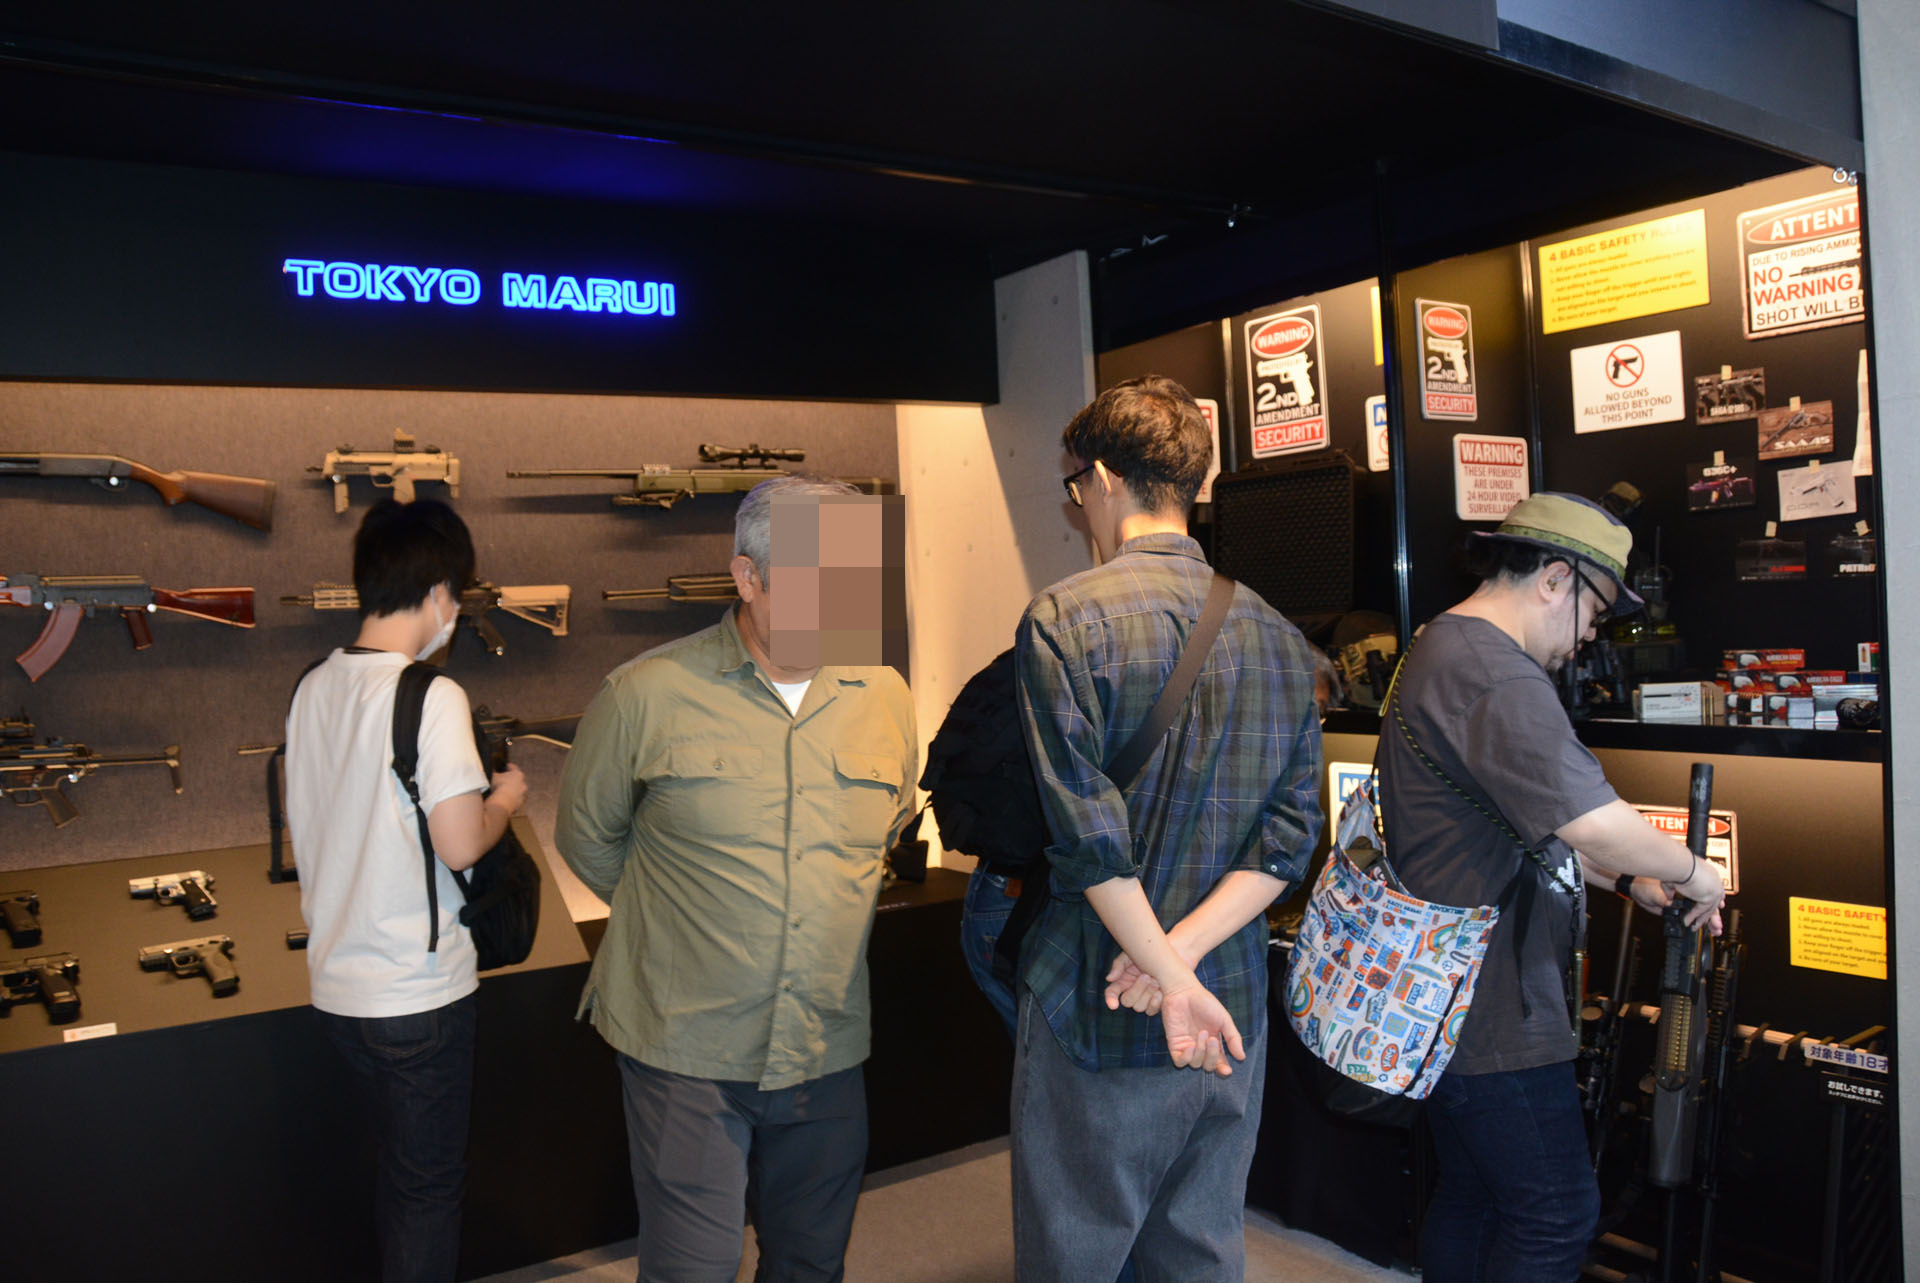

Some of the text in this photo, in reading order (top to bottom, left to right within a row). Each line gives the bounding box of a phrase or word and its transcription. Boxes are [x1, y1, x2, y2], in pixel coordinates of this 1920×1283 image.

[1770, 202, 1859, 241] ATTENT
[1549, 251, 1556, 262] 4
[1559, 242, 1595, 260] BASIC
[1599, 230, 1646, 251] SAFETY
[1752, 237, 1860, 266] DUE TO RISING AMMU
[1753, 266, 1783, 287] NO
[283, 259, 676, 317] TOKYO MARUI
[1754, 273, 1855, 307] WARNING
[1756, 296, 1860, 326] SHOT WILL B
[1428, 315, 1464, 330] WARNING
[1257, 325, 1309, 348] WARNING
[1427, 356, 1458, 381] 2ND
[1256, 382, 1298, 412] 2ND
[1427, 381, 1472, 393] AMENDMENT
[1605, 387, 1649, 402] NO GUNS
[1256, 403, 1320, 426] AMENDMENT
[1428, 396, 1474, 412] SECURITY
[1584, 395, 1672, 416] ALLOWED BEYOND
[1601, 408, 1654, 424] THIS POINT
[1257, 422, 1322, 447] SECURITY
[1461, 442, 1523, 465] WARNING
[1464, 466, 1522, 478] THESE PREMISES
[1474, 479, 1514, 490] ARE UNDER
[1467, 491, 1522, 502] 24 HOUR VIDEO
[1468, 503, 1513, 514] SURVEILLAN
[1798, 904, 1805, 912] 4
[1808, 905, 1841, 916] BASIC
